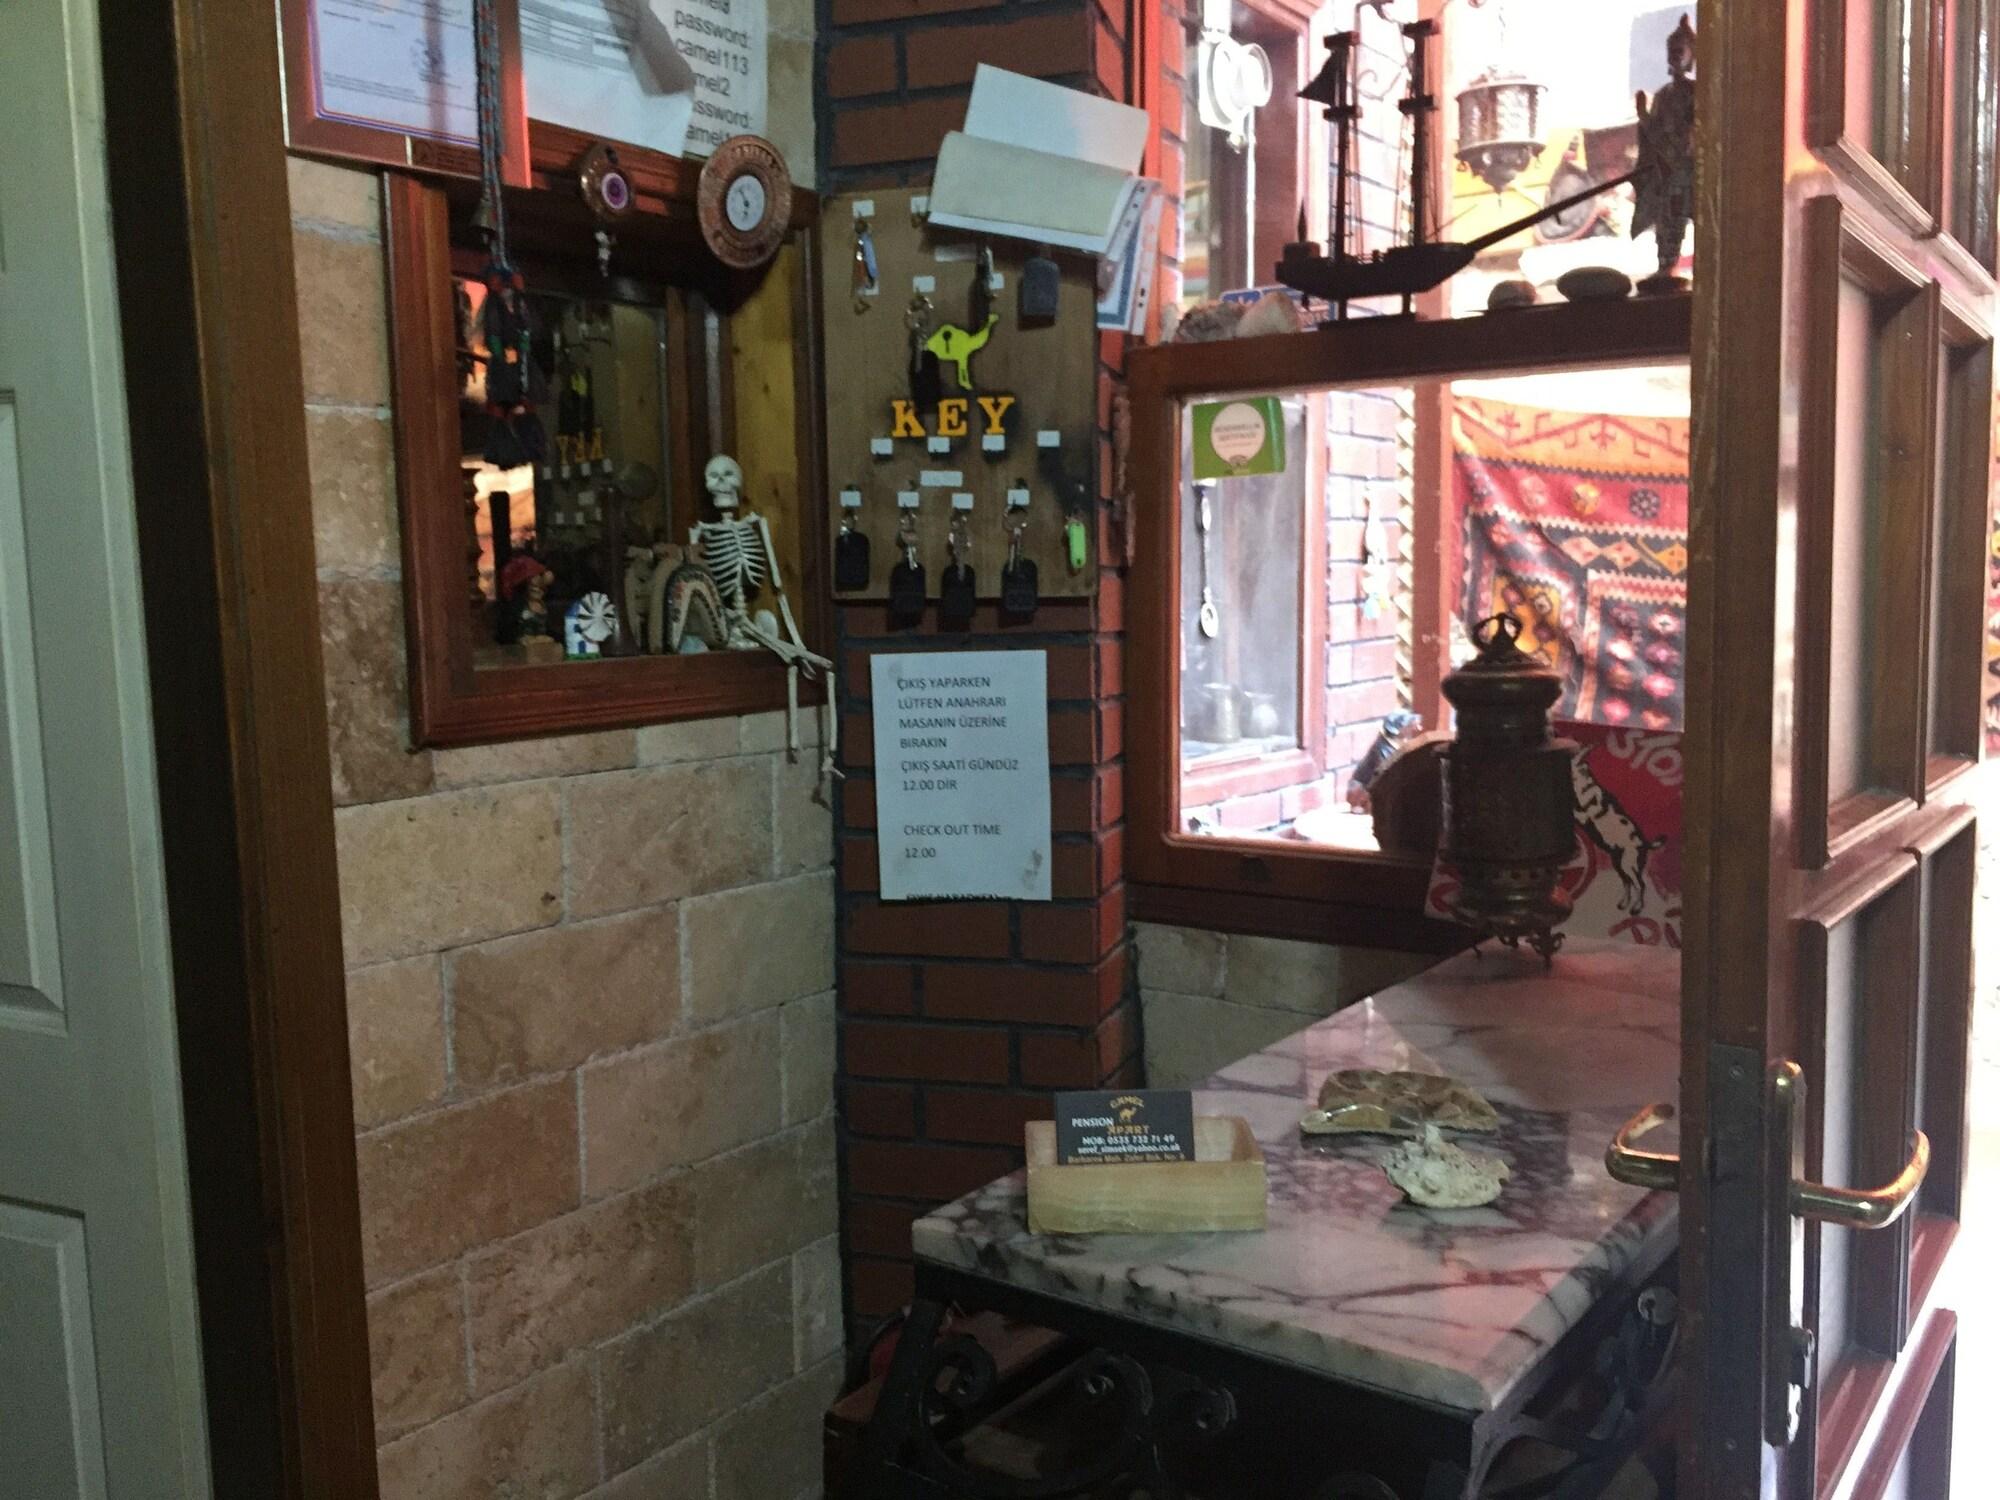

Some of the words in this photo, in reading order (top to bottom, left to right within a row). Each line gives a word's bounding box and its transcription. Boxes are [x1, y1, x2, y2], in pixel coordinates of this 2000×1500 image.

[676, 38, 749, 76] camel113
[694, 72, 730, 97] mel2
[693, 99, 752, 130] ssword:
[892, 396, 1015, 437] KEY
[929, 676, 991, 688] YAPARKEN
[898, 696, 943, 710] LÜTFEN
[899, 718, 956, 729] MASANIN
[900, 737, 948, 749] BIRAKIN
[901, 760, 930, 774] ÇIKIŞ
[903, 824, 941, 836] CHECK
[943, 824, 969, 836] OUT
[972, 824, 1002, 836] TIME
[1071, 1117, 1114, 1128] PENSION
